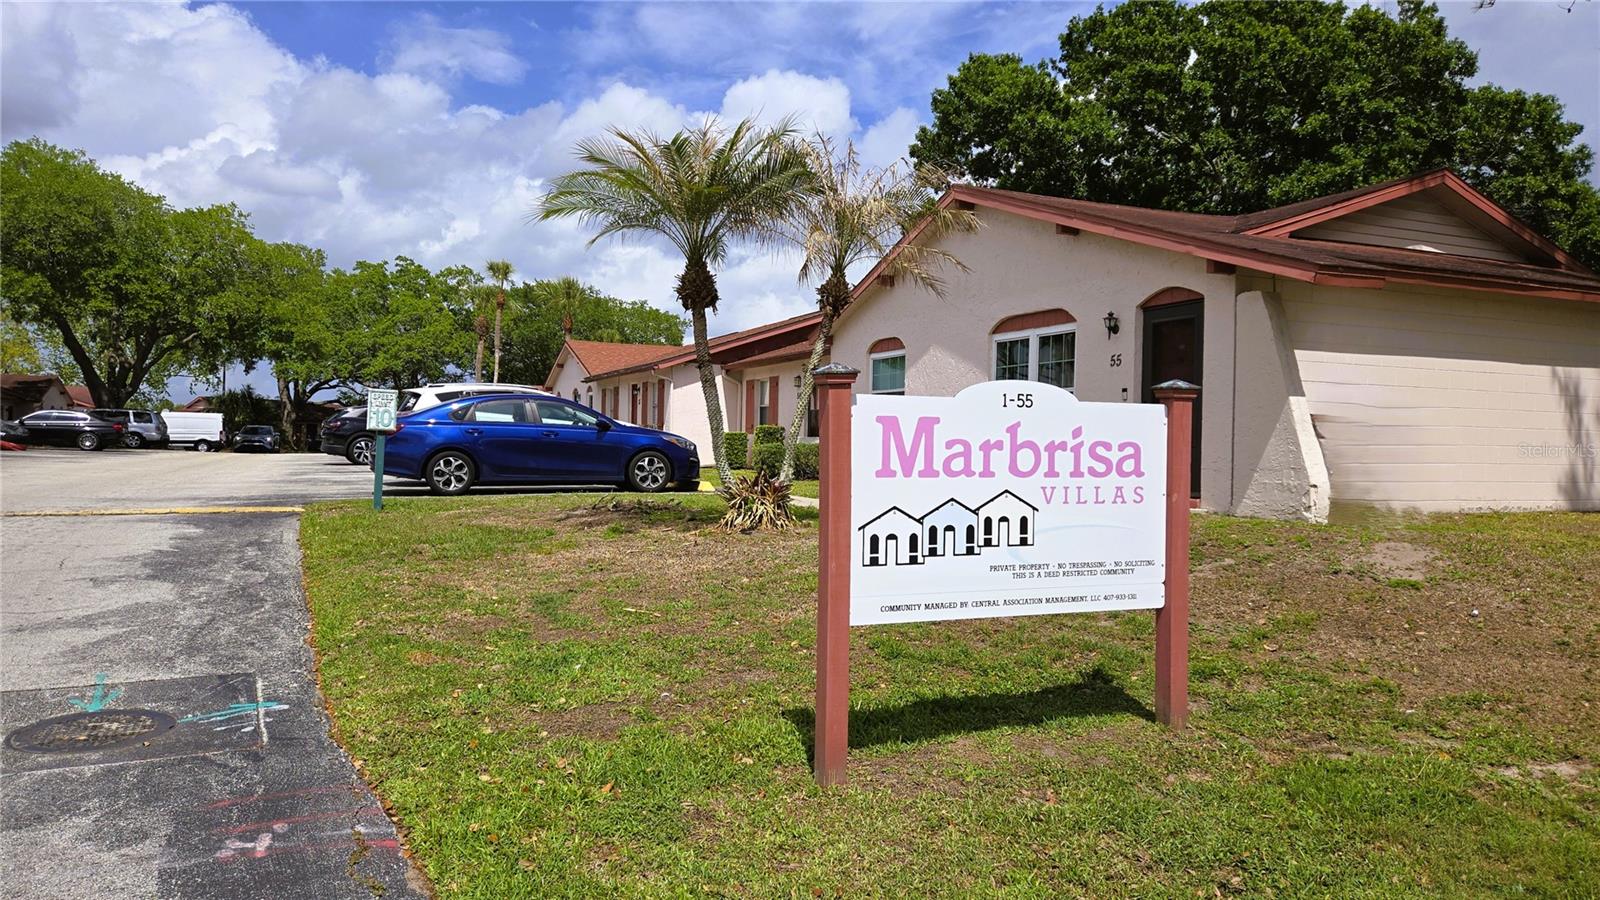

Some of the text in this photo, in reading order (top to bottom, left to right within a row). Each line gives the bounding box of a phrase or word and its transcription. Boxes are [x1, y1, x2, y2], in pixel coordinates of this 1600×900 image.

[1110, 353, 1122, 367] 55
[1002, 393, 1033, 408] 1-55
[368, 409, 392, 427] 10
[875, 416, 1145, 478] Marbrisa
[1041, 486, 1144, 504] VILLAS
[990, 564, 1016, 572] PRIVATE
[1018, 563, 1050, 571] PROPERTY
[1068, 561, 1107, 569] TRESPASSING
[1012, 571, 1027, 579] THIS
[1028, 571, 1035, 579] IS
[1044, 570, 1061, 578] DEED
[1062, 569, 1098, 577] RESTRICTED
[1099, 568, 1135, 576] COMMUNITY
[880, 604, 922, 613] COMMUNITY
[924, 602, 957, 610] MANAGED
[971, 600, 1000, 608] CENTRAL
[1003, 598, 1043, 606] ASSOCIATION
